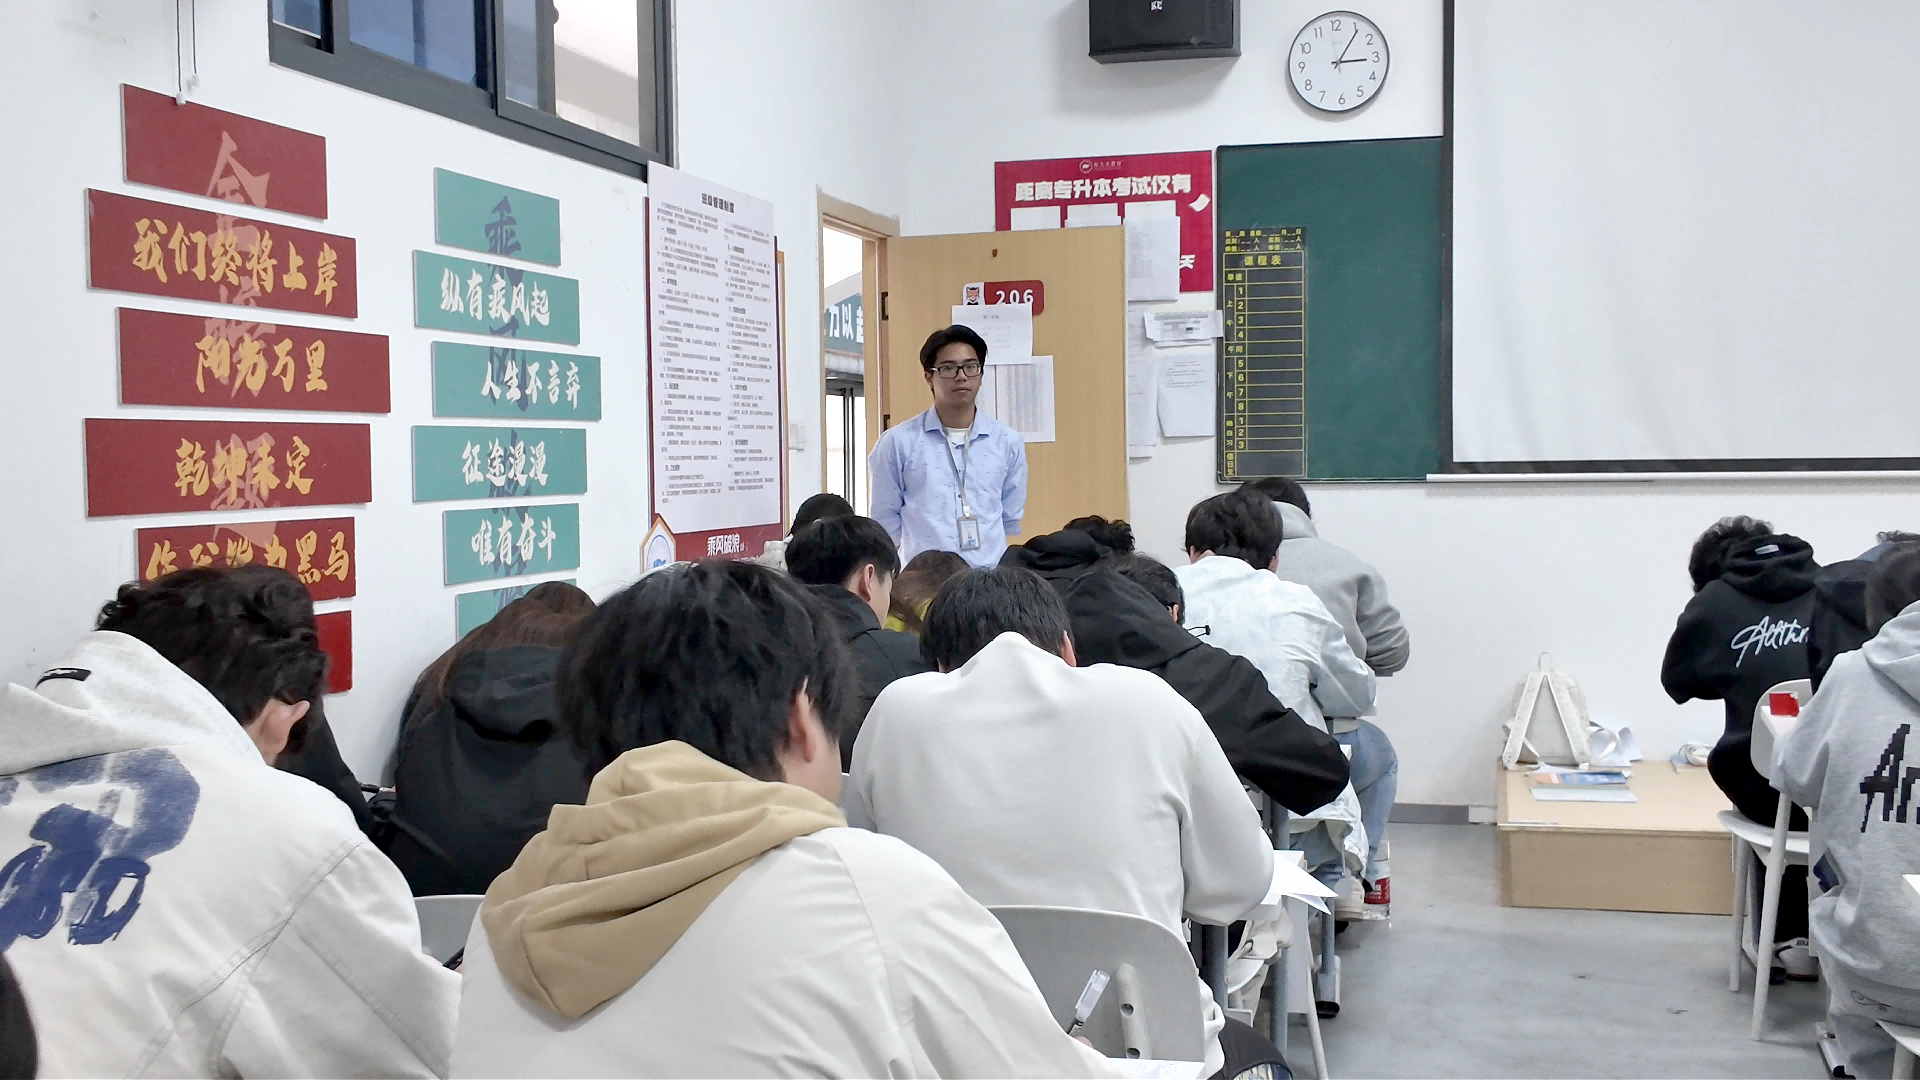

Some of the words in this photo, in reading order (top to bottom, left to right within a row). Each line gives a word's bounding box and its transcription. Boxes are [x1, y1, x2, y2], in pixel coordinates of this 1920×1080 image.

[1330, 19, 1342, 31] 12
[1314, 27, 1323, 39] 11
[1365, 34, 1373, 45] 2
[1300, 42, 1311, 54] 10
[1372, 51, 1380, 63] 3
[1298, 62, 1306, 73] 9
[1369, 71, 1377, 81] 4
[1305, 79, 1312, 91] 8
[1318, 91, 1326, 102] 7
[1356, 86, 1364, 97] 5
[1338, 93, 1346, 104] 6
[1014, 173, 1192, 202] 距离专升本考试仅有
[132, 217, 338, 307] 我们终将上岸
[1179, 254, 1196, 270] 天
[1244, 255, 1282, 266] 课程表
[1238, 287, 1243, 295] 1
[995, 289, 1035, 305] 206
[1237, 301, 1244, 309] 2
[1237, 316, 1244, 324] 3
[196, 332, 328, 393] 阳光万里
[1238, 360, 1244, 368] 5
[1238, 373, 1244, 382] 6
[481, 360, 580, 410] 人生不言弃
[1238, 388, 1244, 396] 7
[1238, 402, 1244, 411] 8
[1239, 417, 1244, 425] 1
[1238, 440, 1244, 449] 3
[462, 437, 548, 487] 征途漫漫
[175, 435, 315, 503] 乾坤未定
[471, 513, 557, 566] 唯有奋斗
[707, 533, 740, 557] 乘风破浪
